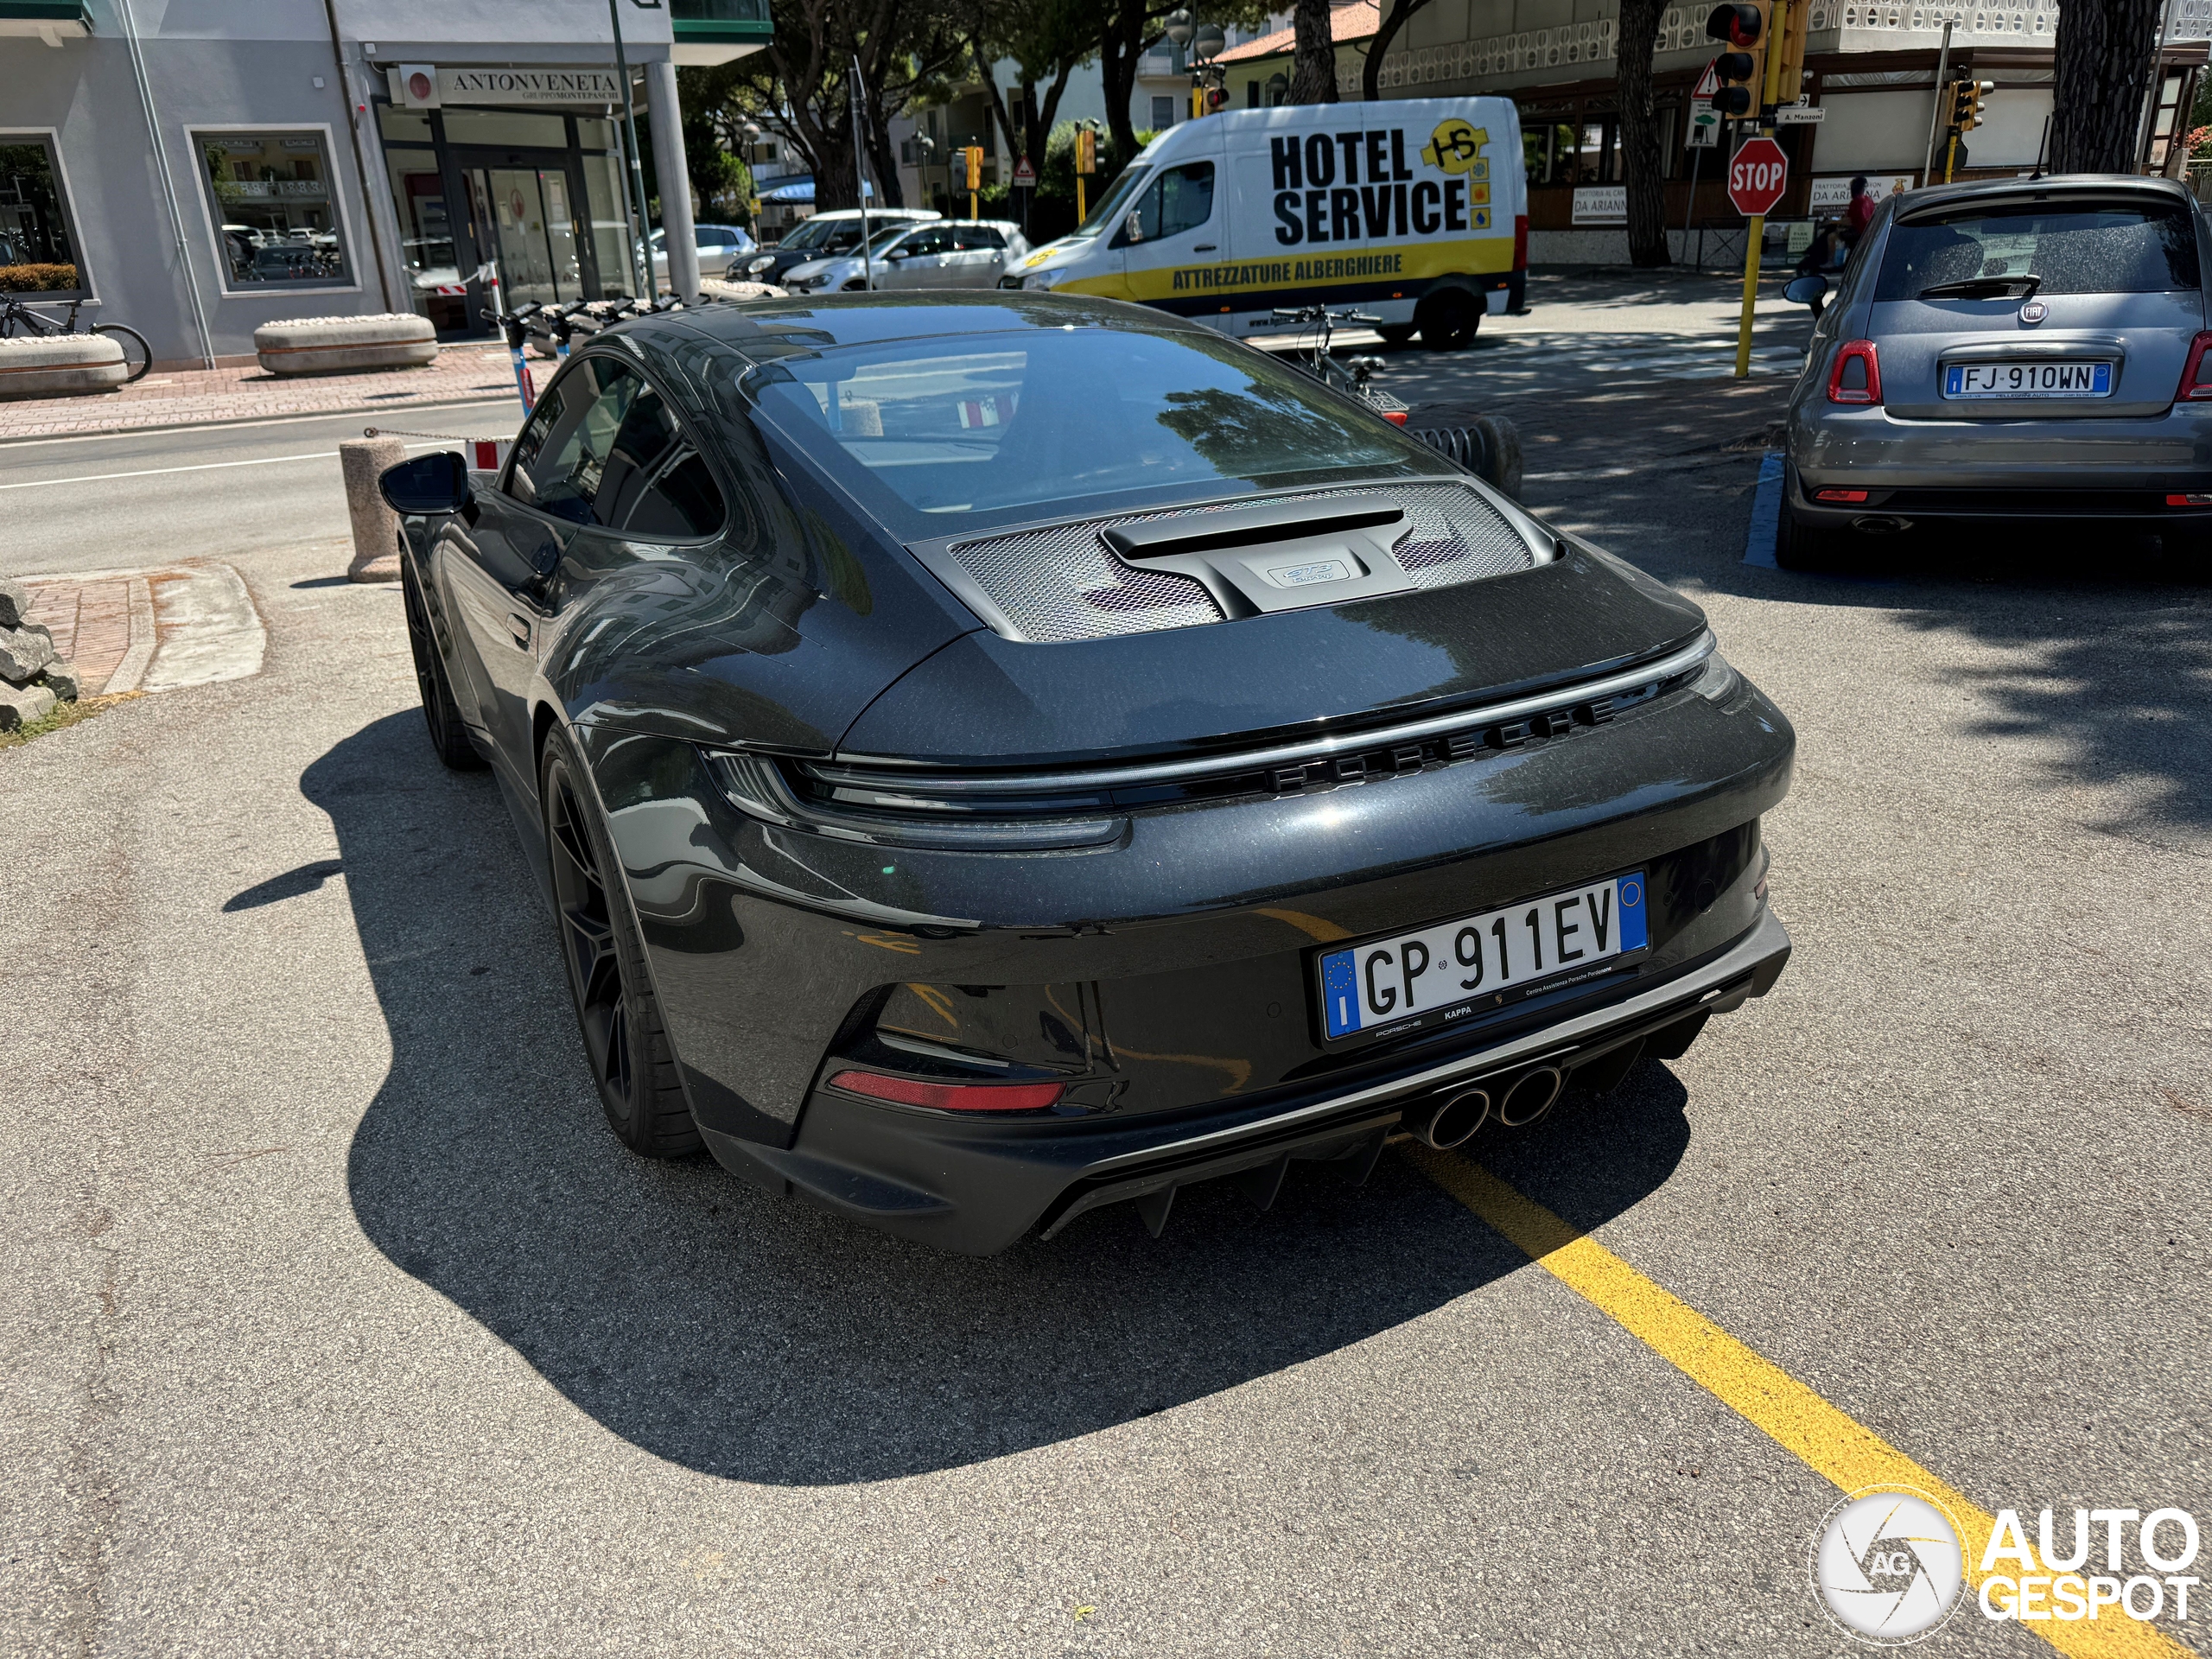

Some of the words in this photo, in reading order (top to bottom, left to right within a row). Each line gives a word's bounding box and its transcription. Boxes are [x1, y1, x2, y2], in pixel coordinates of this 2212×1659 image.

[454, 73, 617, 92] ANTONVENETA
[1270, 128, 1414, 191] HOTEL
[1732, 162, 1783, 191] STOP
[1574, 200, 1588, 213] DA
[1576, 189, 1604, 198] TRATTORIA
[1813, 191, 1828, 201] DA
[1273, 179, 1467, 246] SERVICE
[1173, 261, 1291, 290] ATTREZZATURE
[1295, 253, 1402, 282] ALBERGHIERE
[2025, 306, 2044, 317] FIAT
[1965, 367, 1997, 391] FJ
[2008, 365, 2091, 390] 910WN
[1283, 563, 1332, 578] GT3
[1273, 701, 1615, 791] PORSCHE
[1364, 940, 1430, 1016] GP
[1453, 887, 1611, 991] 911EV
[1375, 1020, 1422, 1038] PORSCHE
[1444, 1005, 1472, 1020] KAPPA
[1525, 988, 1543, 996] Centro
[1542, 979, 1568, 991] Assistenza
[1567, 974, 1587, 983] Porsche
[1587, 966, 1612, 977] Pordenone
